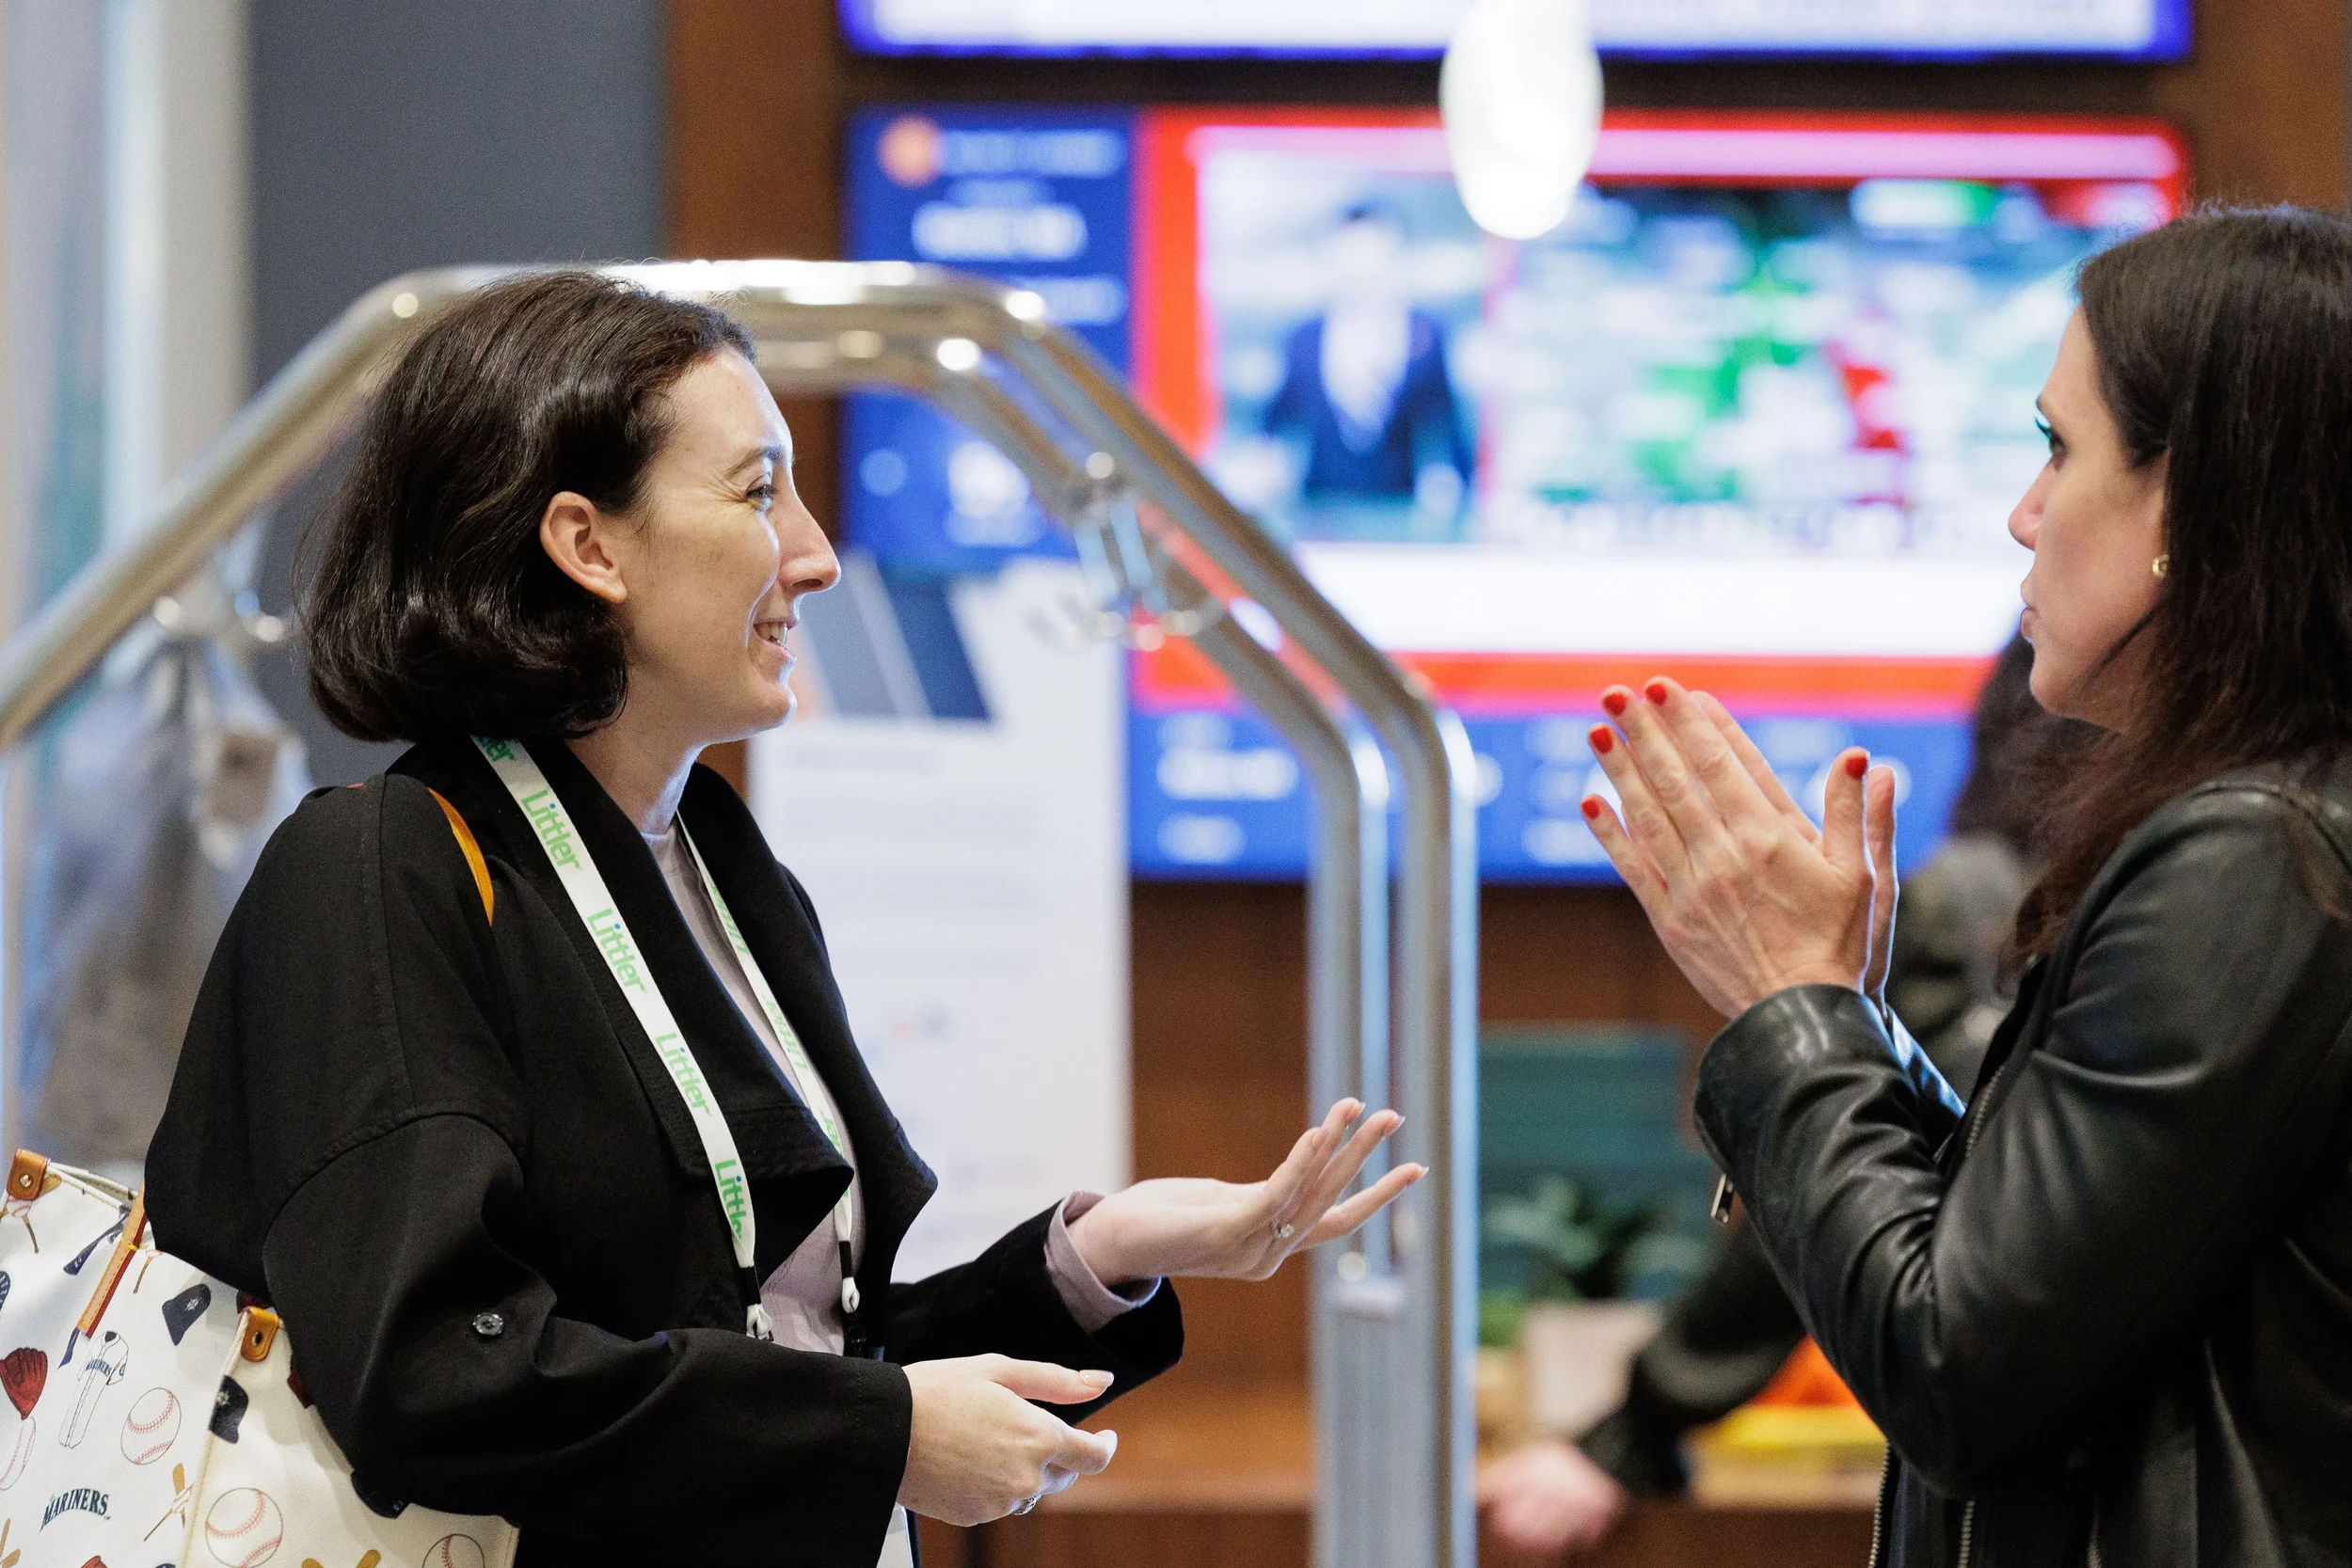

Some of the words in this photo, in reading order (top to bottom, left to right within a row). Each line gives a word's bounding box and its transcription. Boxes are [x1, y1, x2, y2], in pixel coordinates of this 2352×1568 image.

[520, 789, 581, 867] Littler
[586, 907, 646, 993] Littler
[655, 1032, 710, 1115] Littler
[39, 1488, 109, 1533] MARINERS
